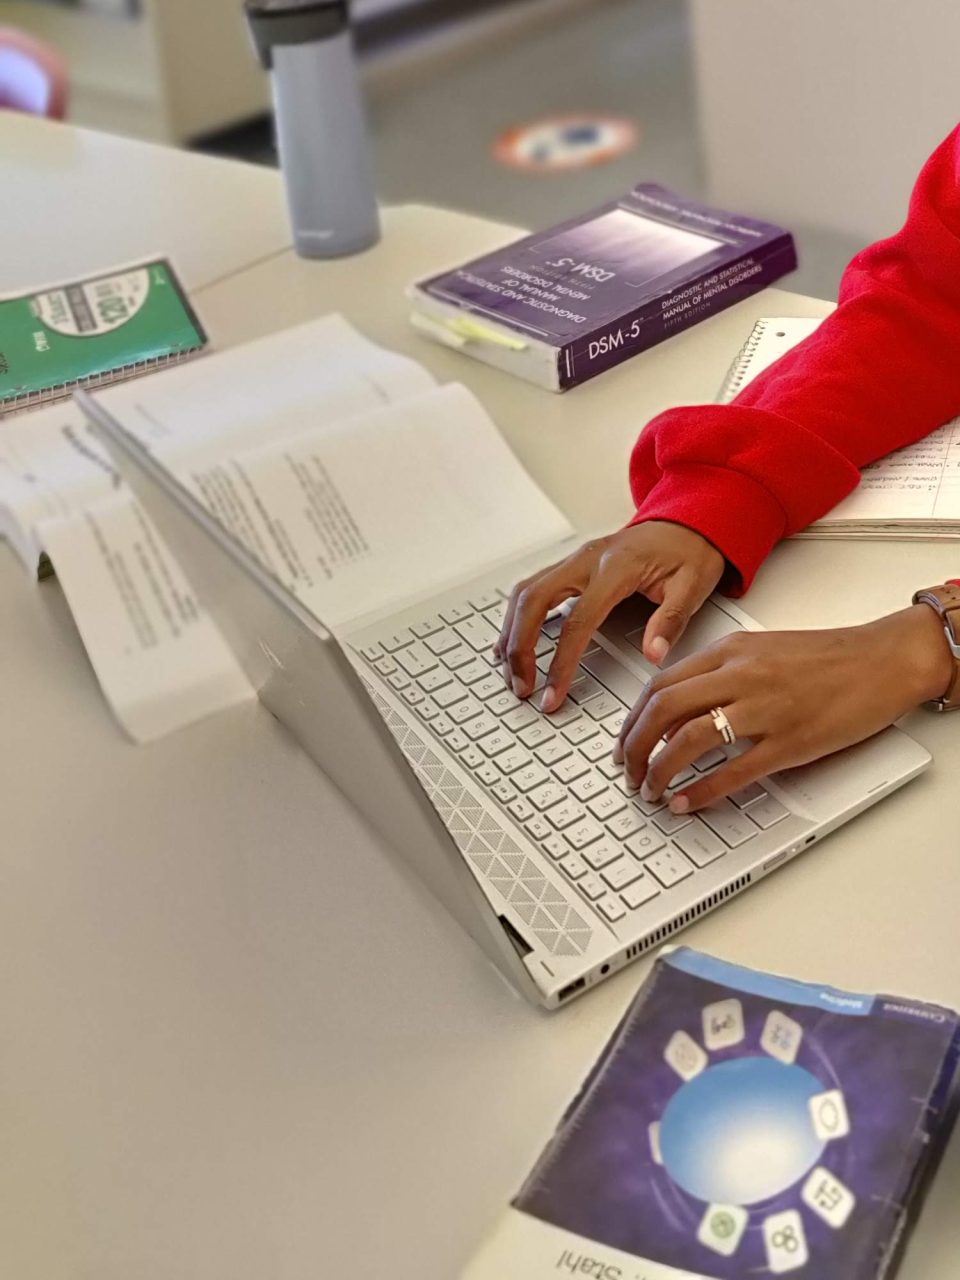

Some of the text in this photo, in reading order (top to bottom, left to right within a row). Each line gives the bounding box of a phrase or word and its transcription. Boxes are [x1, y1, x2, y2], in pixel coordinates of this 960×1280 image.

[501, 265, 592, 301] MENTAL DISORDERS
[521, 283, 560, 302] MANUAL
[661, 258, 755, 309] DIAGNOSTIC AND STATISTICAL
[663, 264, 763, 320] MANUAL OF MENTAL DISORDERS
[522, 296, 587, 324] DIAGNOSTIC
[555, 1248, 624, 1280] Stahl
